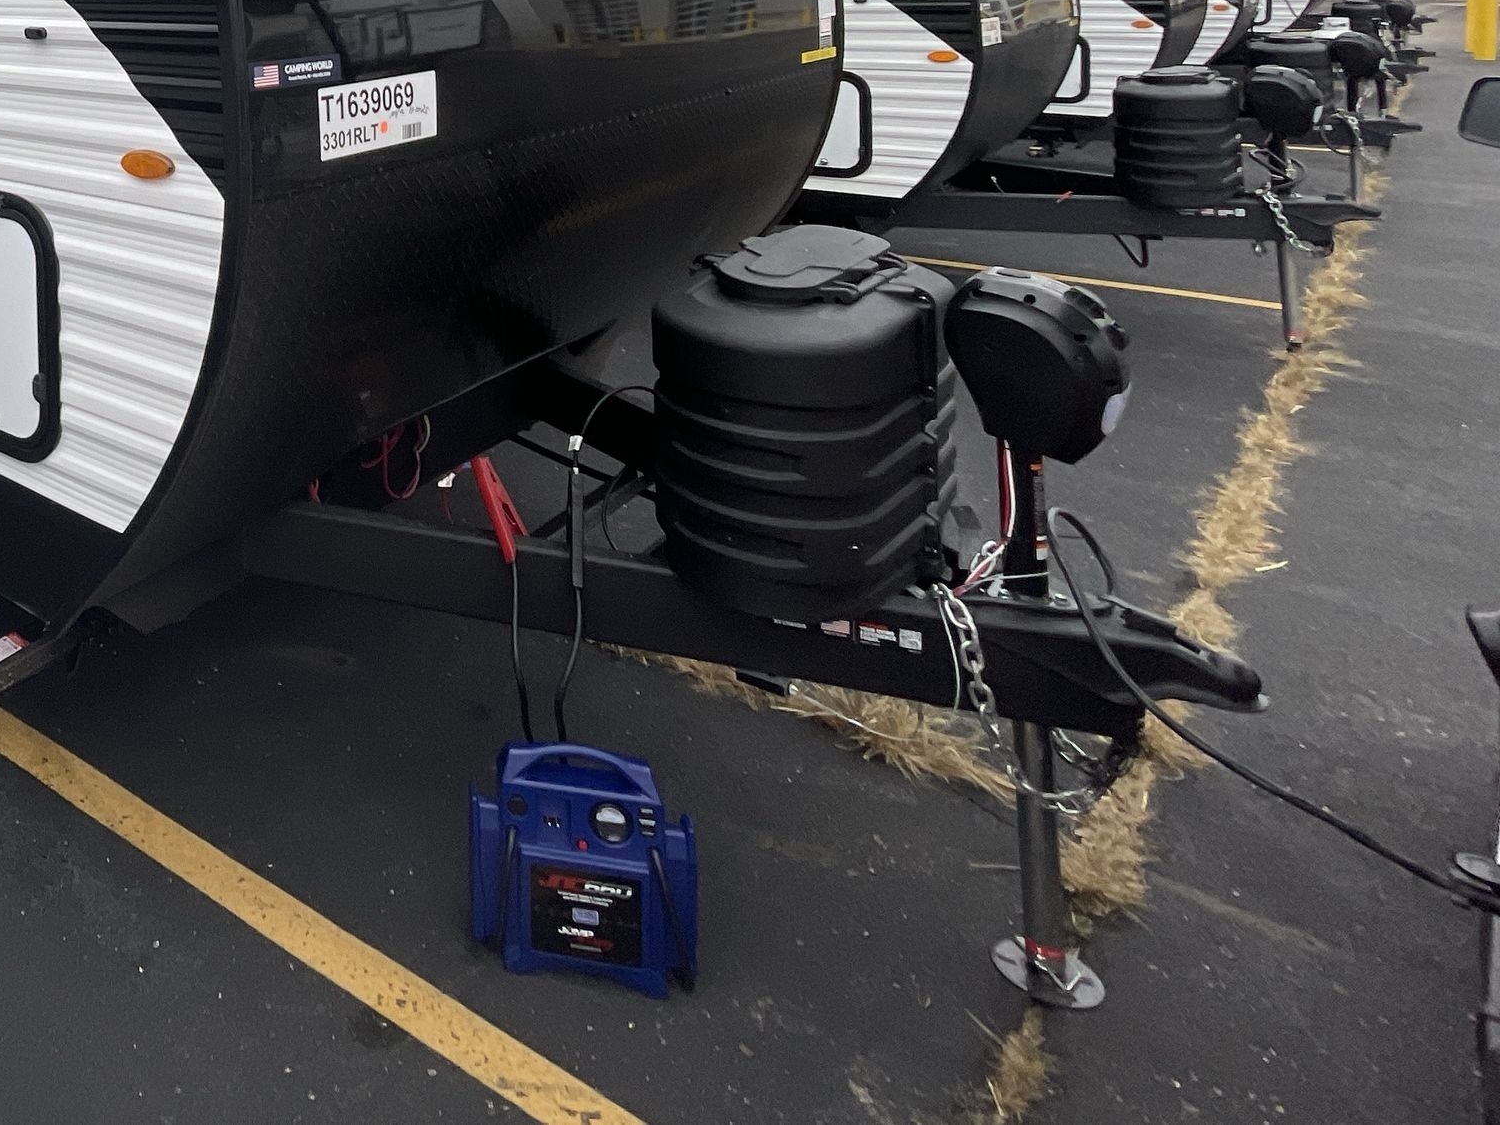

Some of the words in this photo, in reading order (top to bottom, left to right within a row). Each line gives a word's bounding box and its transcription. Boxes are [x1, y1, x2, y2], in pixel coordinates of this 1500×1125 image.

[284, 62, 312, 74] CAMPING
[312, 60, 334, 71] WORLD
[321, 82, 414, 122] T1639069
[323, 123, 379, 151] 3301RLT
